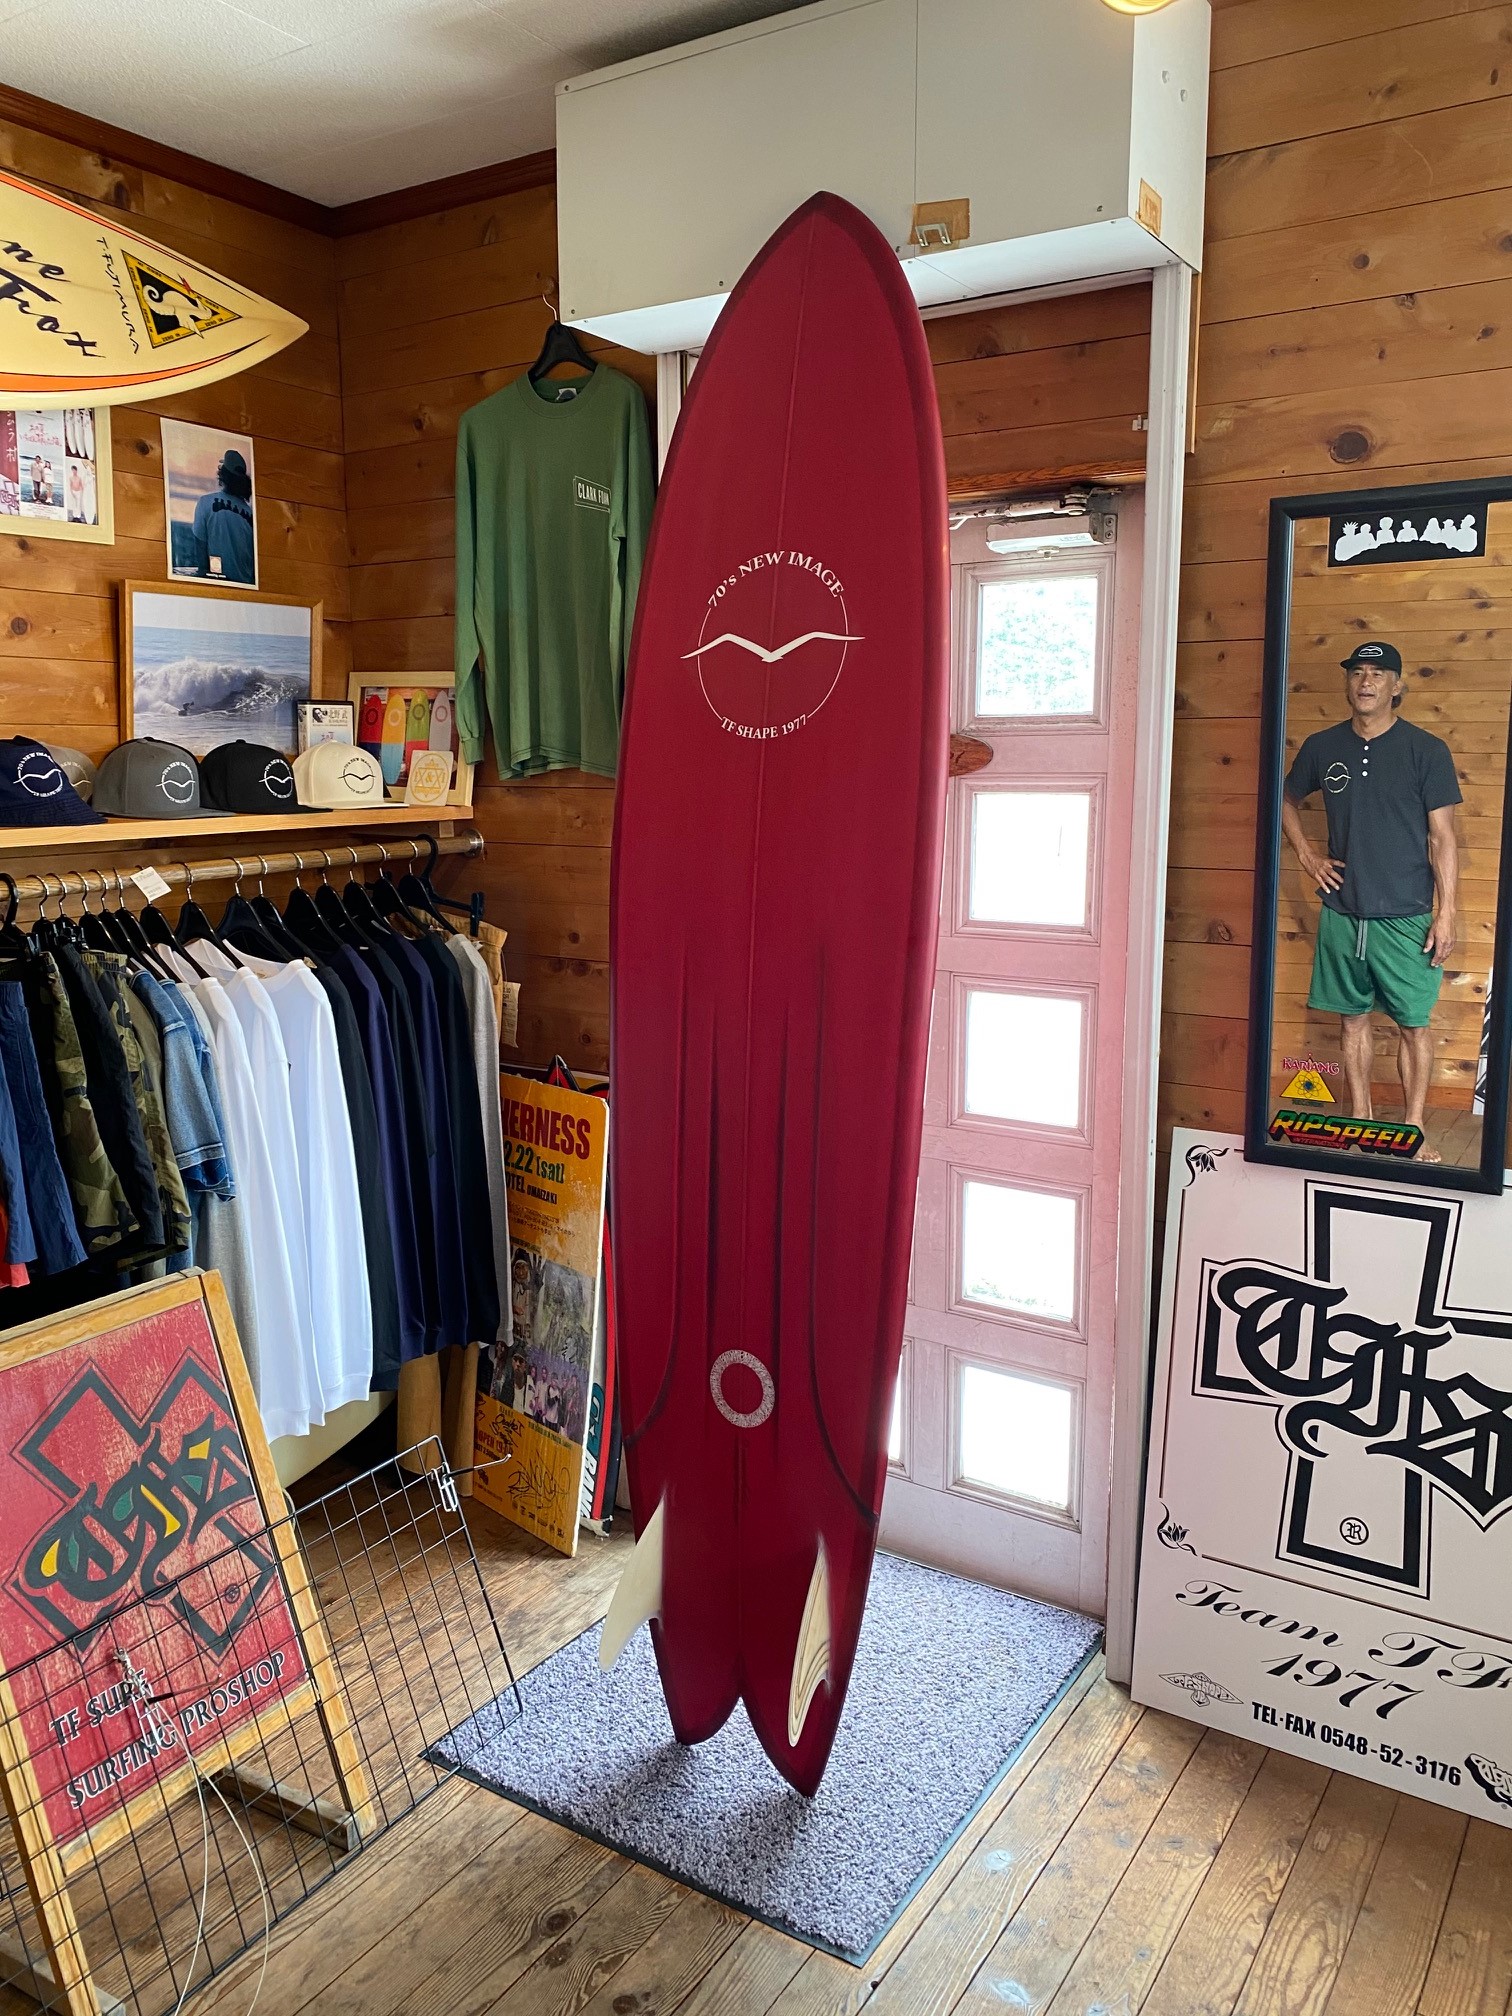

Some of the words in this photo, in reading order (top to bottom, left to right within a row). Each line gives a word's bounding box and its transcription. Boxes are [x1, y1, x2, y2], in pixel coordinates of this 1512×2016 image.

[578, 482, 597, 502] CLARK
[707, 574, 737, 607] 70's
[738, 550, 785, 577] NEW
[788, 551, 845, 598] IMAGE
[720, 716, 737, 732] TF
[736, 725, 779, 739] SHAPE
[781, 714, 808, 735] 1977
[1268, 1109, 1425, 1159] RIPSPEED
[1175, 1580, 1344, 1647] Team
[1261, 1653, 1425, 1719] 1977
[49, 1707, 81, 1748] TF
[67, 1721, 177, 1809] SURFING
[179, 1651, 285, 1738] PROSHOP
